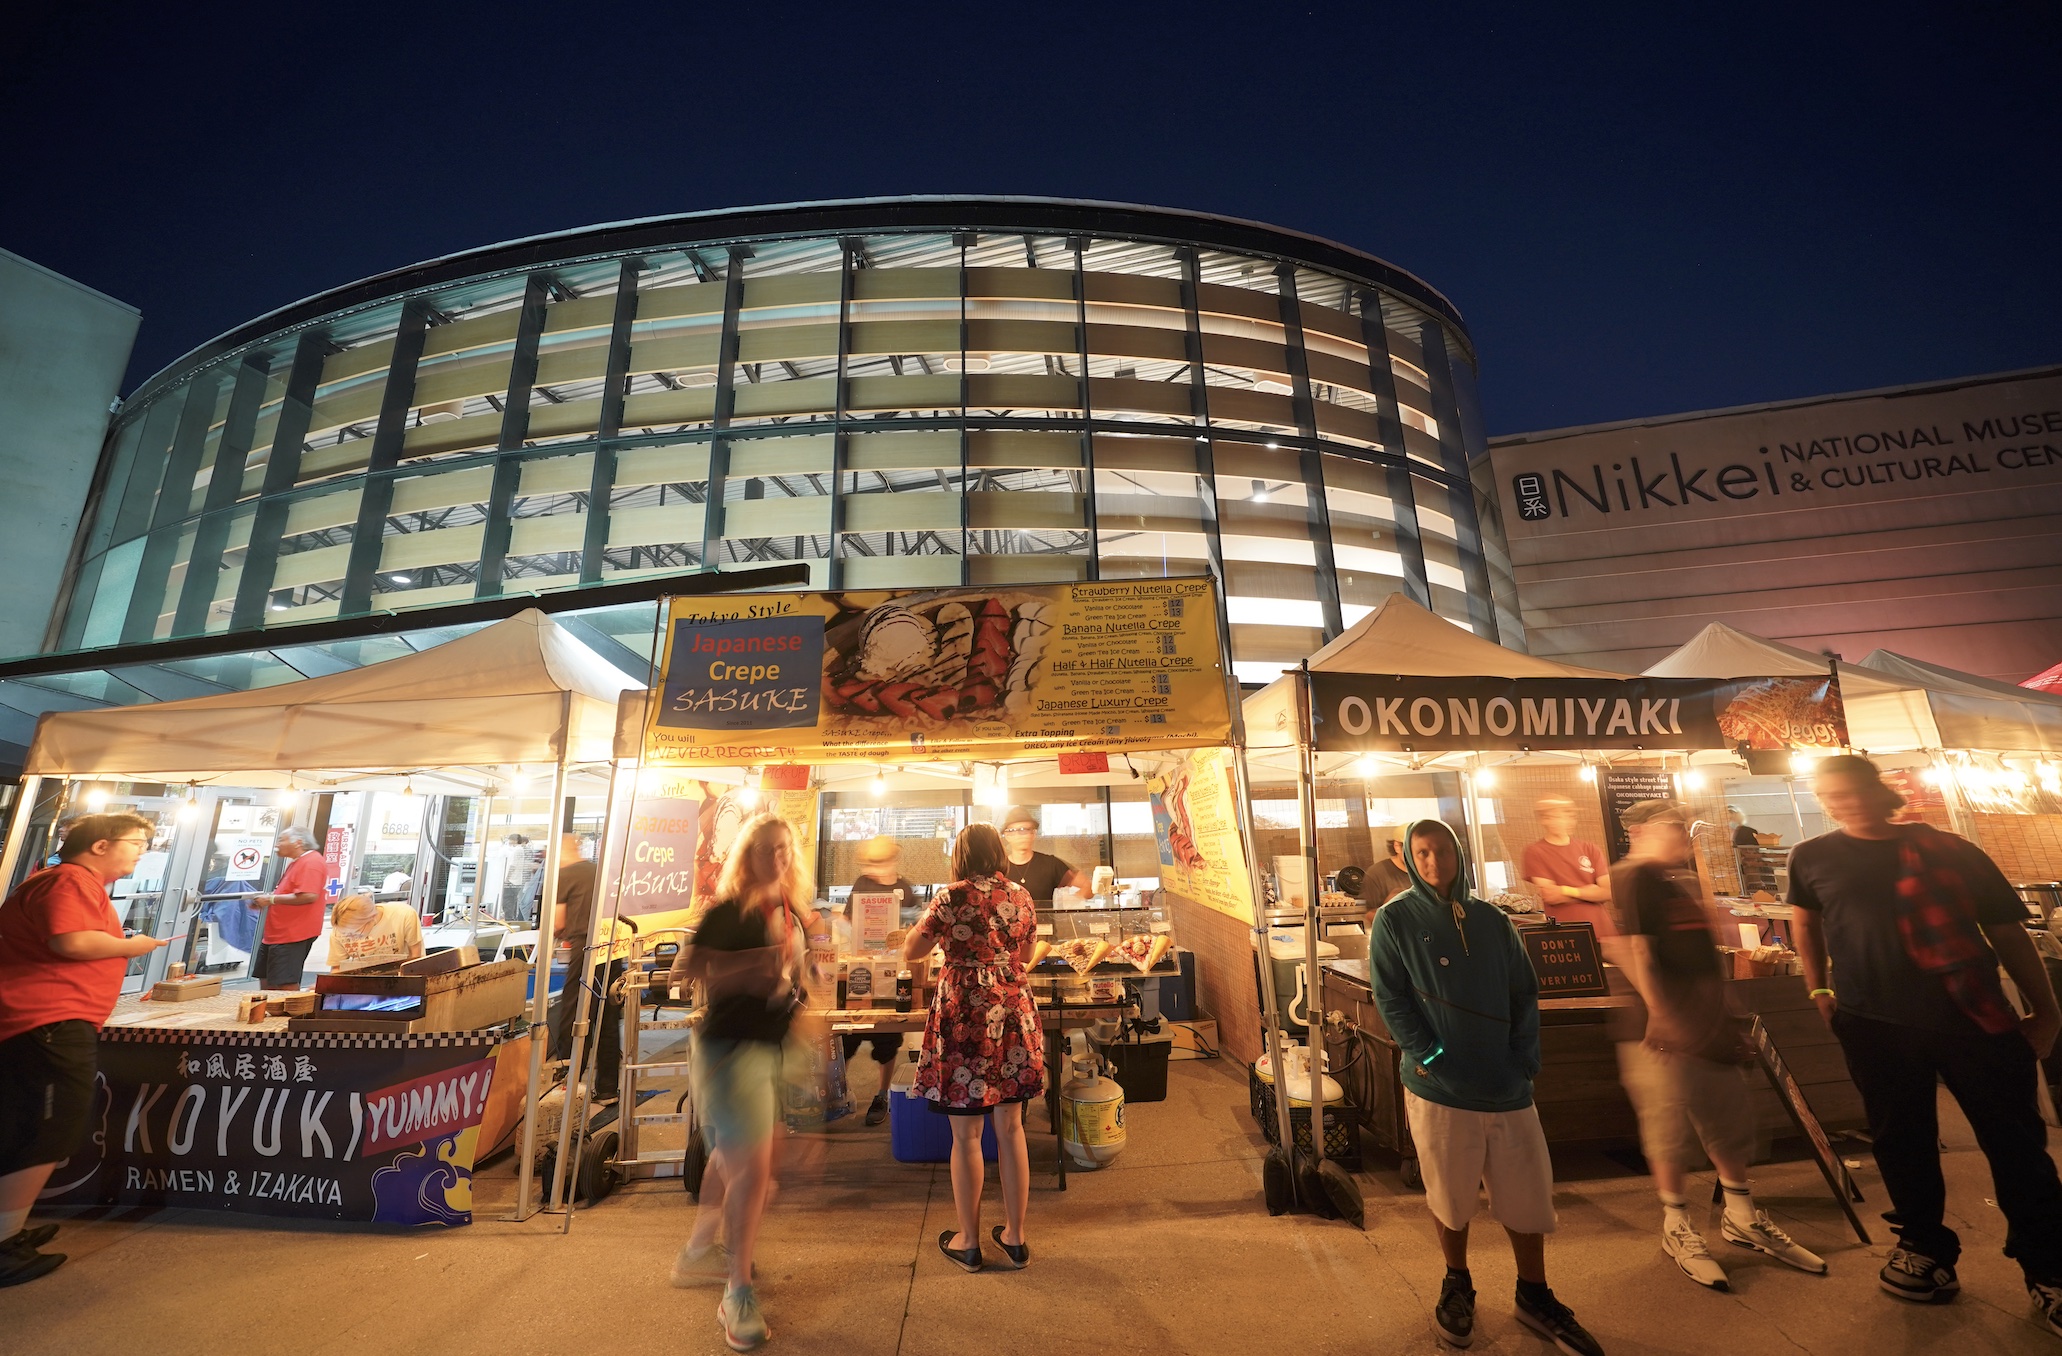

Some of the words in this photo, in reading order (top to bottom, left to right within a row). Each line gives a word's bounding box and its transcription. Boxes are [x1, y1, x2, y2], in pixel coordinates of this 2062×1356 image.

[1780, 426, 1953, 462] NATIONAL
[1791, 472, 1814, 492] &
[1821, 453, 1990, 488] CULTURAL
[1552, 447, 1780, 518] Nikkei
[1518, 476, 1547, 517] 日系
[1072, 587, 1129, 598] Strawberry
[1134, 585, 1172, 594] Nutella
[1176, 584, 1207, 594] Crepe
[688, 612, 739, 626] Tokyo
[748, 601, 791, 618] Style
[1063, 624, 1102, 635] Banana
[1106, 622, 1145, 633] Nutella
[1149, 620, 1180, 630] Crepe
[692, 634, 802, 656] Japanese
[1164, 646, 1174, 654] 13
[1053, 661, 1077, 671] Half
[1090, 658, 1115, 669] Half
[1118, 657, 1157, 668] Nutella
[1161, 657, 1193, 667] Crepe
[709, 661, 780, 684] Crepe
[1158, 674, 1168, 684] 12
[1160, 685, 1170, 694] 13
[673, 688, 808, 714] SASUKE
[1037, 700, 1088, 710] Japanese
[1091, 698, 1130, 708] Luxury
[1134, 697, 1168, 707] Crepe
[1152, 714, 1162, 723] 13
[1338, 696, 1682, 736] OKONOMIYAKI
[653, 732, 674, 742] You
[678, 734, 695, 743] will
[822, 729, 860, 737] SASUKE
[1041, 728, 1075, 737] Topping
[652, 746, 714, 759] NEVER
[714, 746, 796, 759] REGRET!!
[1061, 755, 1106, 766] ORDER
[763, 768, 805, 779] PICK-UP
[382, 823, 409, 835] 6688
[627, 815, 689, 836] apanese
[342, 831, 350, 852] FIRST
[635, 841, 674, 867] Crepe
[610, 871, 688, 897] SASUKE
[1541, 939, 1575, 950] DON'T
[1542, 953, 1581, 964] TOUCH
[1540, 976, 1567, 985] VERY
[1572, 974, 1593, 983] HOT
[176, 1051, 318, 1082] 和風居酒屋
[368, 1069, 492, 1143] YUMMY!
[124, 1083, 363, 1161] KOYUKI
[126, 1166, 215, 1192] RAMEN
[224, 1170, 240, 1195] &
[249, 1170, 342, 1206] IZAKAYA
